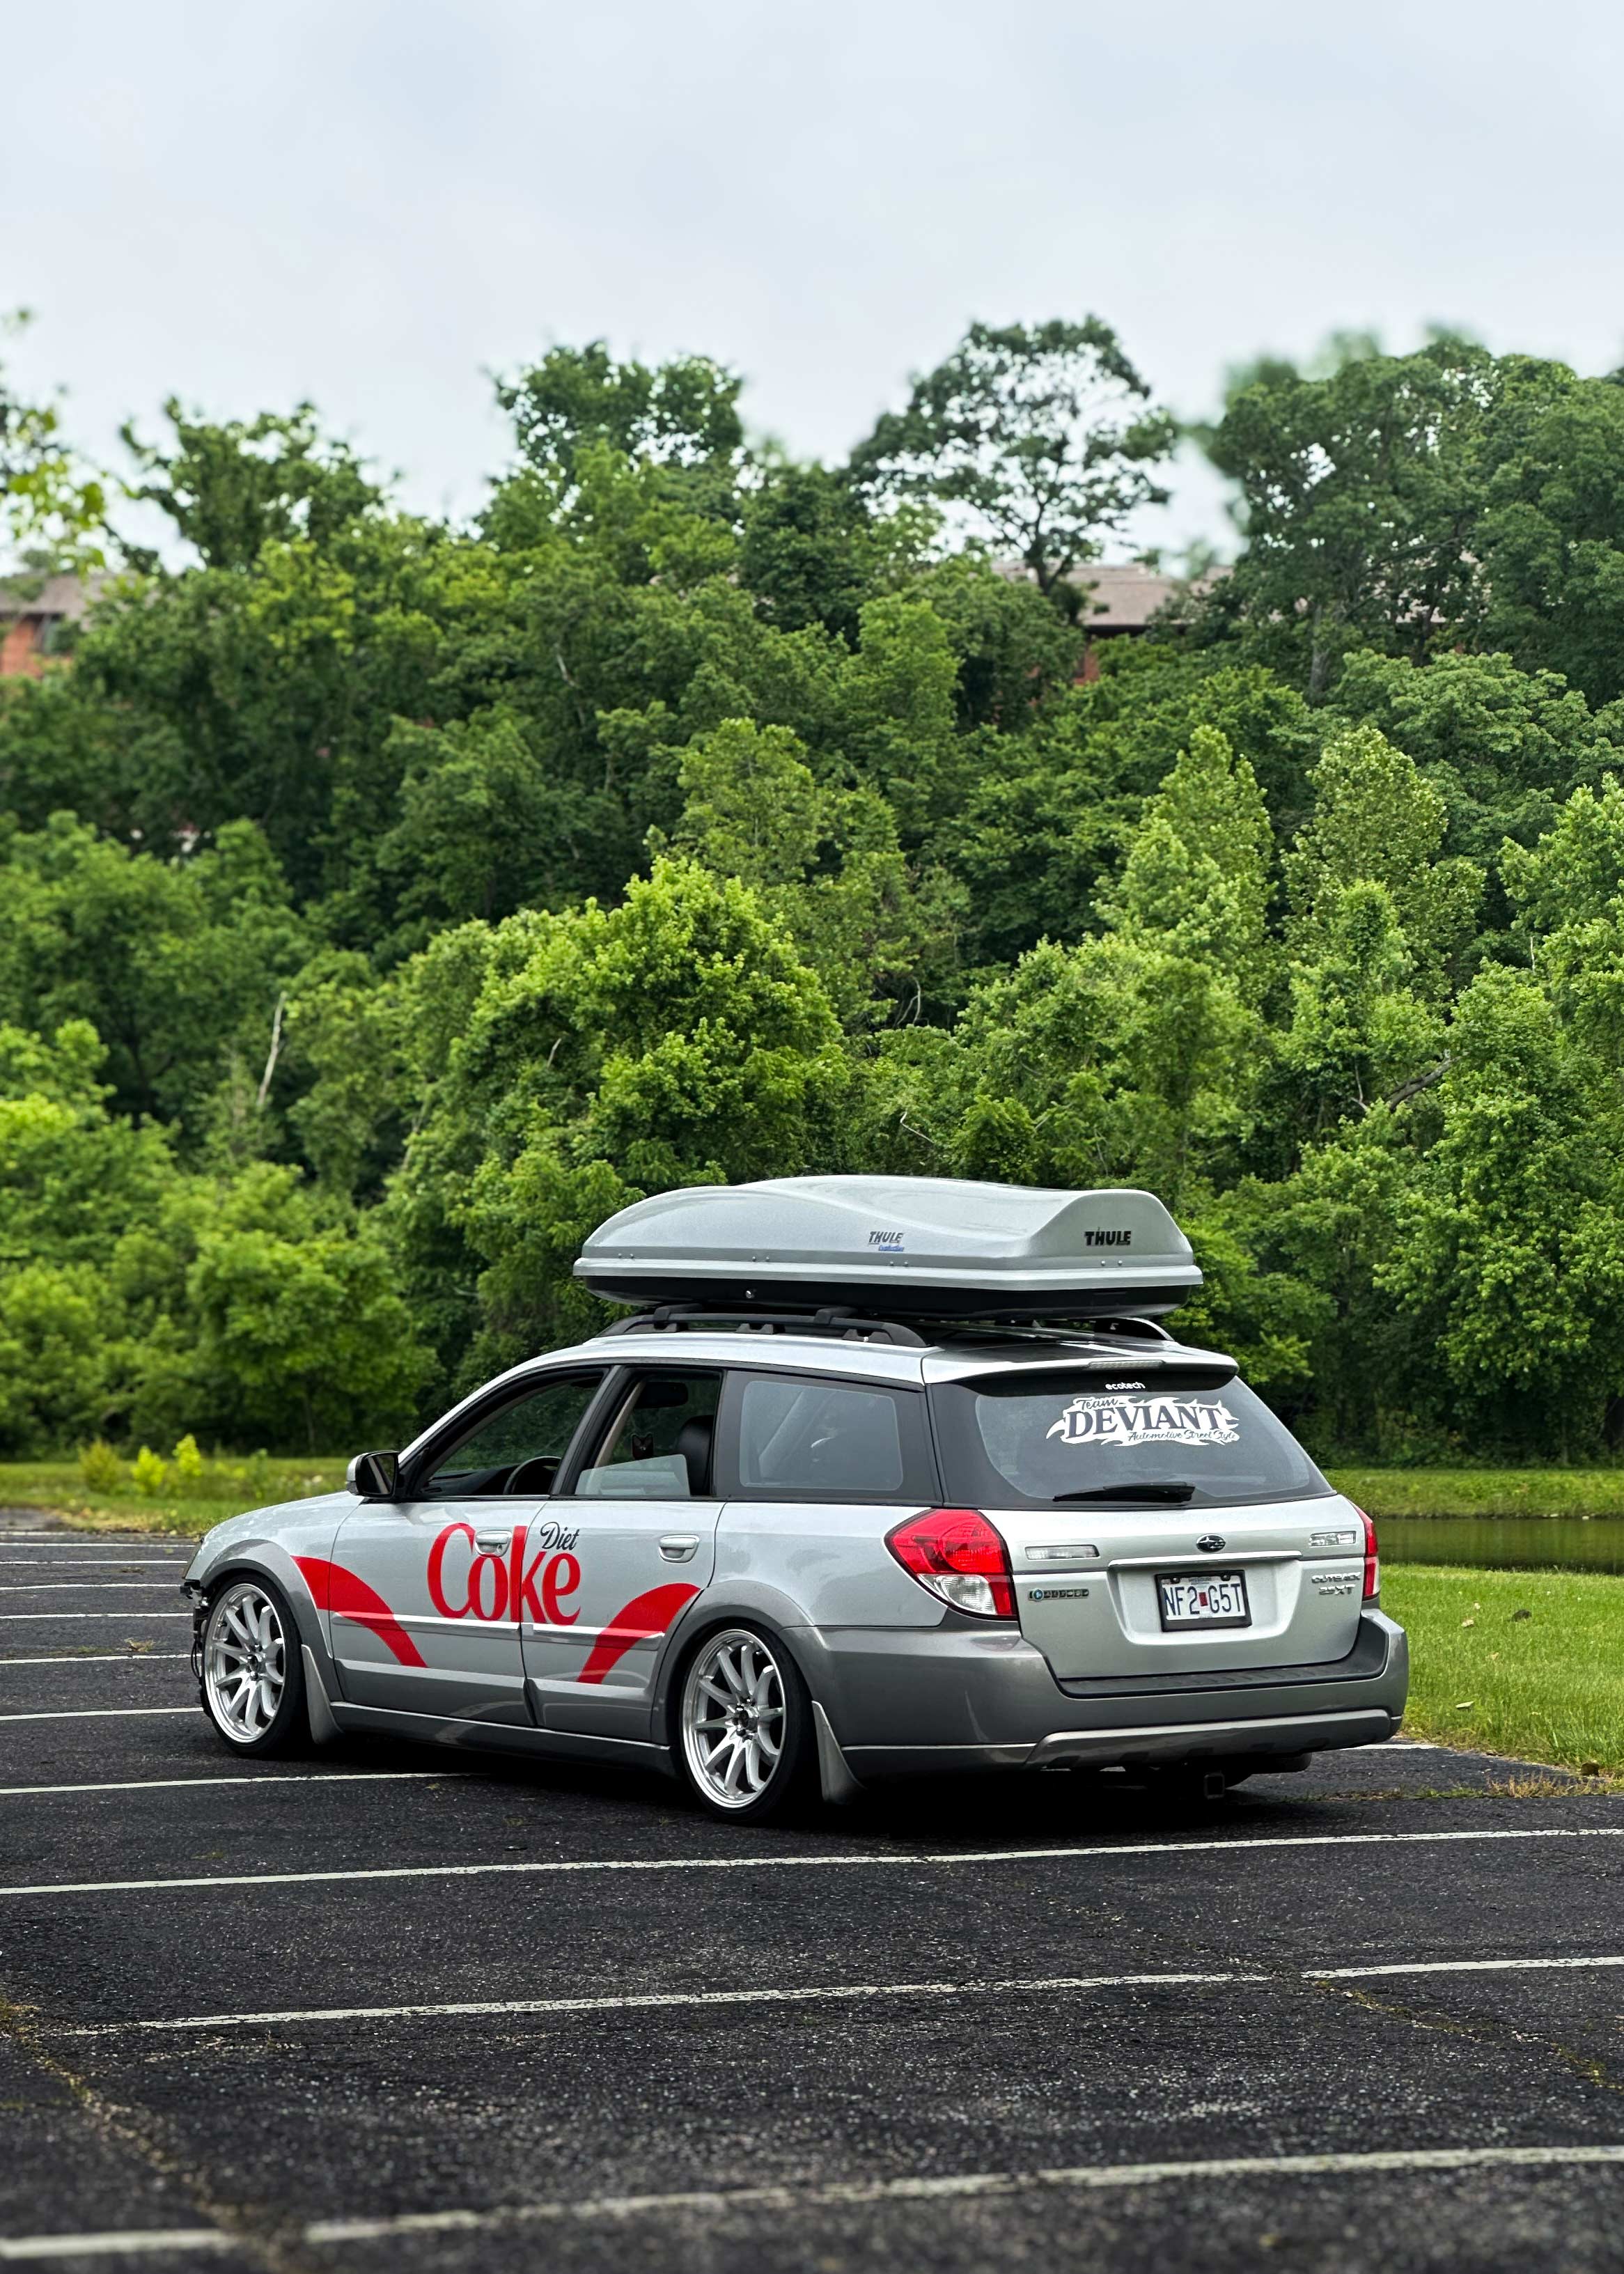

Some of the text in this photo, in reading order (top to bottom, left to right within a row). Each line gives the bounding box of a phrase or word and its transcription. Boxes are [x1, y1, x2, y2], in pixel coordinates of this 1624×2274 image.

[868, 1231, 904, 1244] THULE
[1084, 1231, 1132, 1246] THULE
[1104, 1382, 1146, 1391] ecotech
[1080, 1399, 1118, 1410] Team
[1066, 1405, 1222, 1439] DEVIANT
[1127, 1430, 1182, 1441] Automotive
[540, 1521, 580, 1551] Diet
[427, 1522, 581, 1626] Coke
